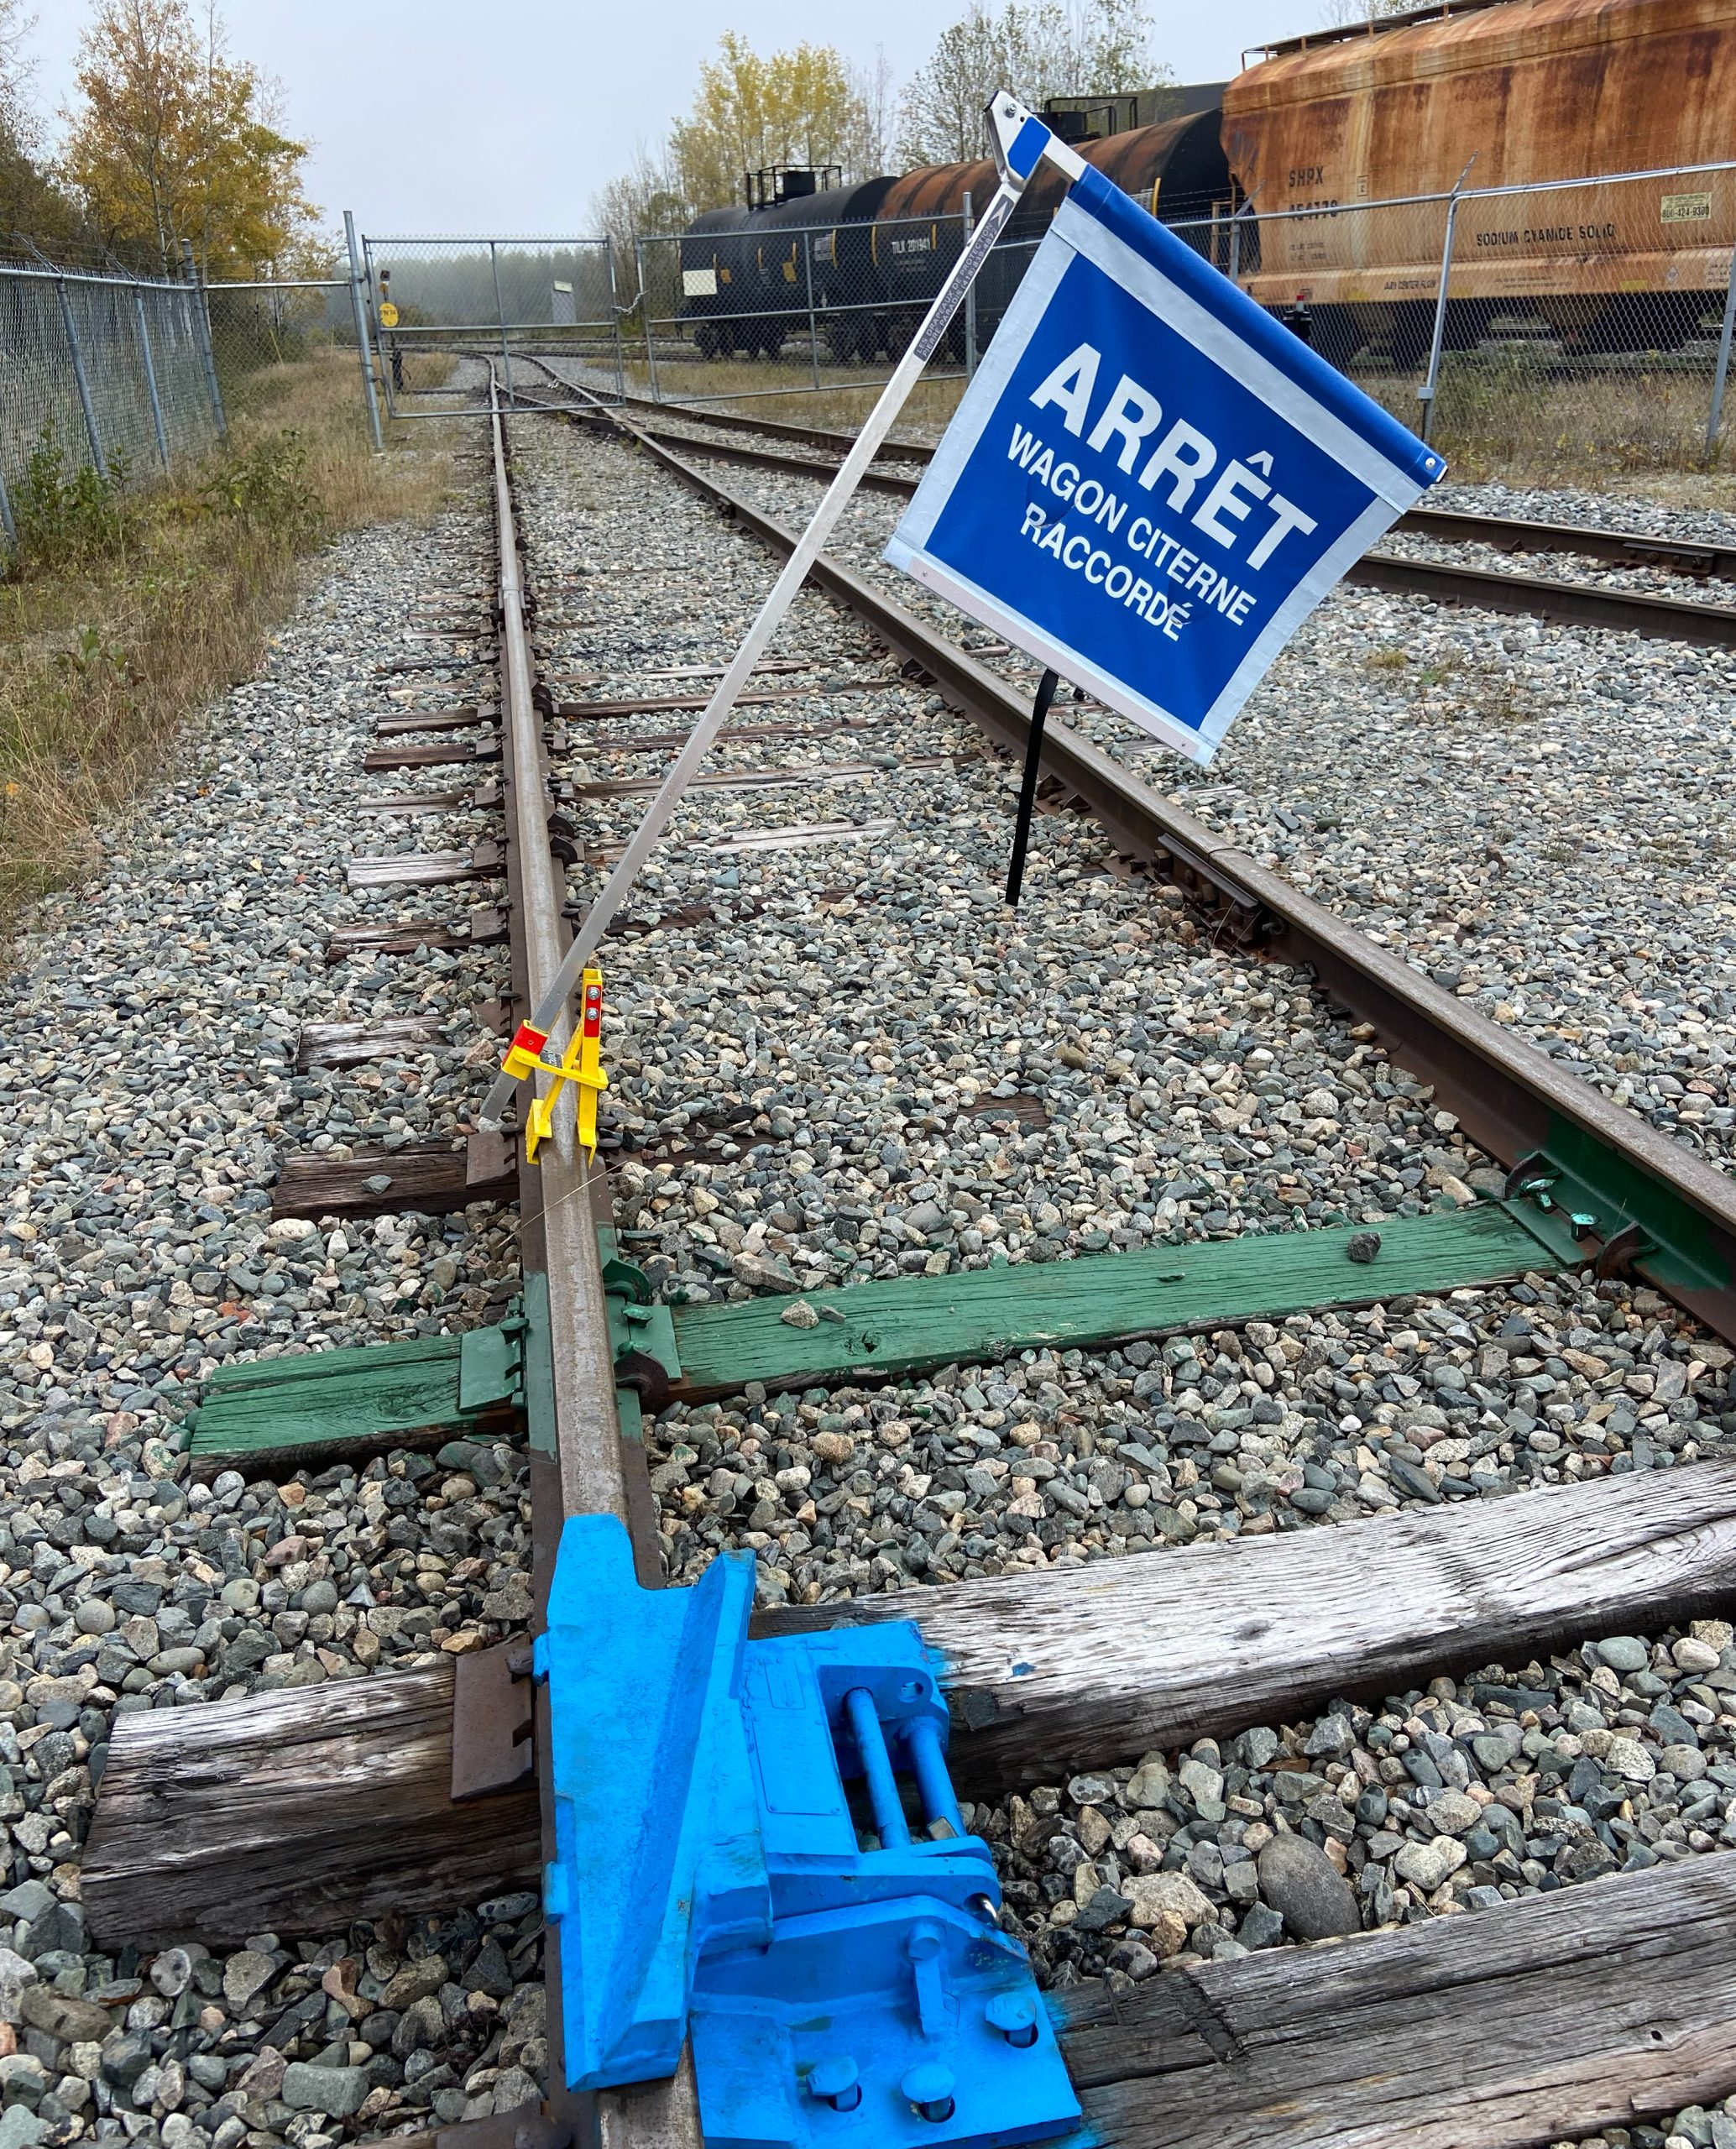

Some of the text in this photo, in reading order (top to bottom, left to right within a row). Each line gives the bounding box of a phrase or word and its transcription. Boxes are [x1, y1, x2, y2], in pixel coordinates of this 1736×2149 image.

[1289, 166, 1324, 187] SHPX
[1477, 223, 1615, 246] SODIUM CYANIDE SOLID
[917, 222, 993, 353] LES DRAPEAUX DE PROTECTION
[922, 327, 941, 358] PIERRE
[939, 290, 963, 327] PARADIS
[1028, 342, 1318, 572] ARRÊT
[1007, 423, 1258, 626] WAGON CITERNE
[1020, 502, 1193, 641] RACCORDÉ
